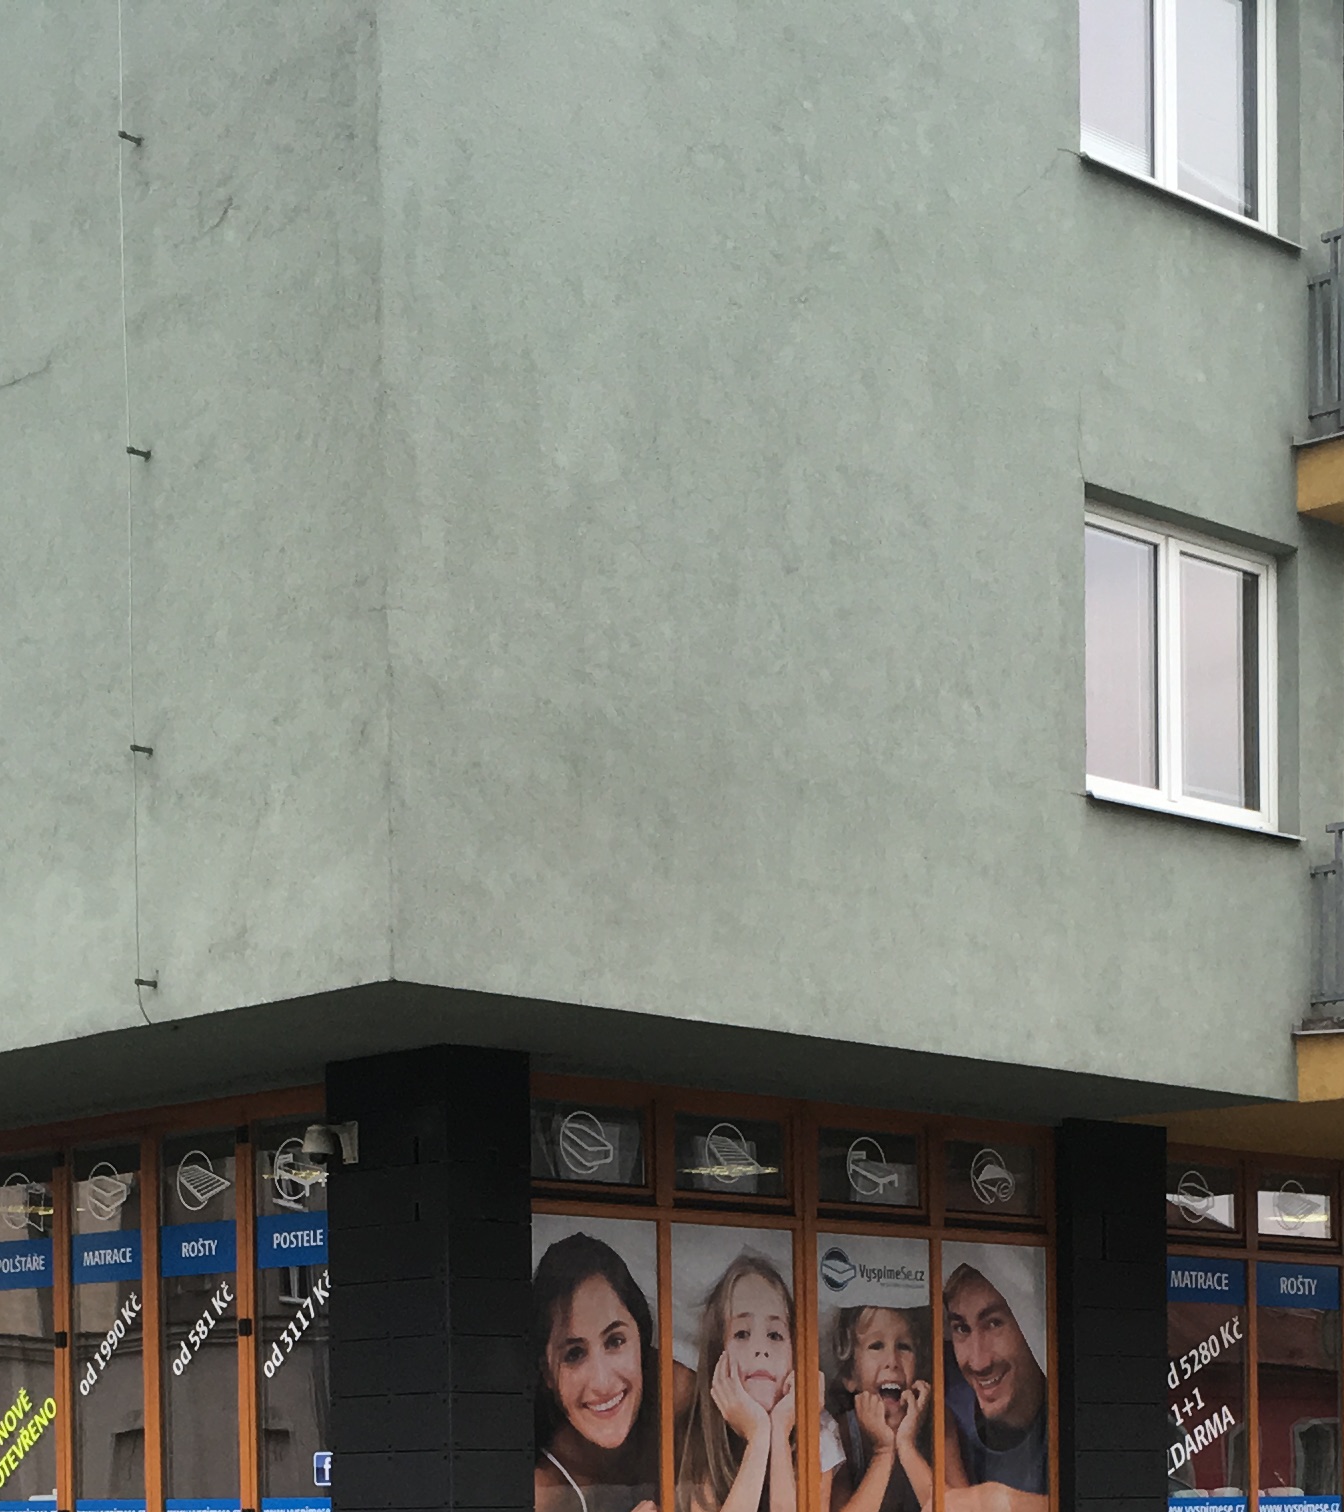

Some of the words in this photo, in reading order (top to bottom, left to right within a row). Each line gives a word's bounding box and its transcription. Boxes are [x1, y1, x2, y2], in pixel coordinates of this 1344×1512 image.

[181, 1237, 218, 1258] ROŠTY
[272, 1229, 324, 1249] POSTELE
[83, 1247, 133, 1267] MATRACE
[1170, 1270, 1229, 1291] MATRACE
[1279, 1275, 1317, 1296] ROŠTY
[172, 1341, 192, 1376] od
[188, 1310, 216, 1352] 581
[211, 1281, 234, 1316] Kč
[262, 1343, 284, 1379] od
[280, 1298, 317, 1353] 3117
[79, 1362, 98, 1397] od
[94, 1319, 126, 1369] 1990
[123, 1291, 142, 1325] Kč
[1167, 1362, 1180, 1389] d
[1180, 1334, 1221, 1380] 5280
[1219, 1315, 1243, 1349] Kč
[1170, 1387, 1205, 1426] 1+1
